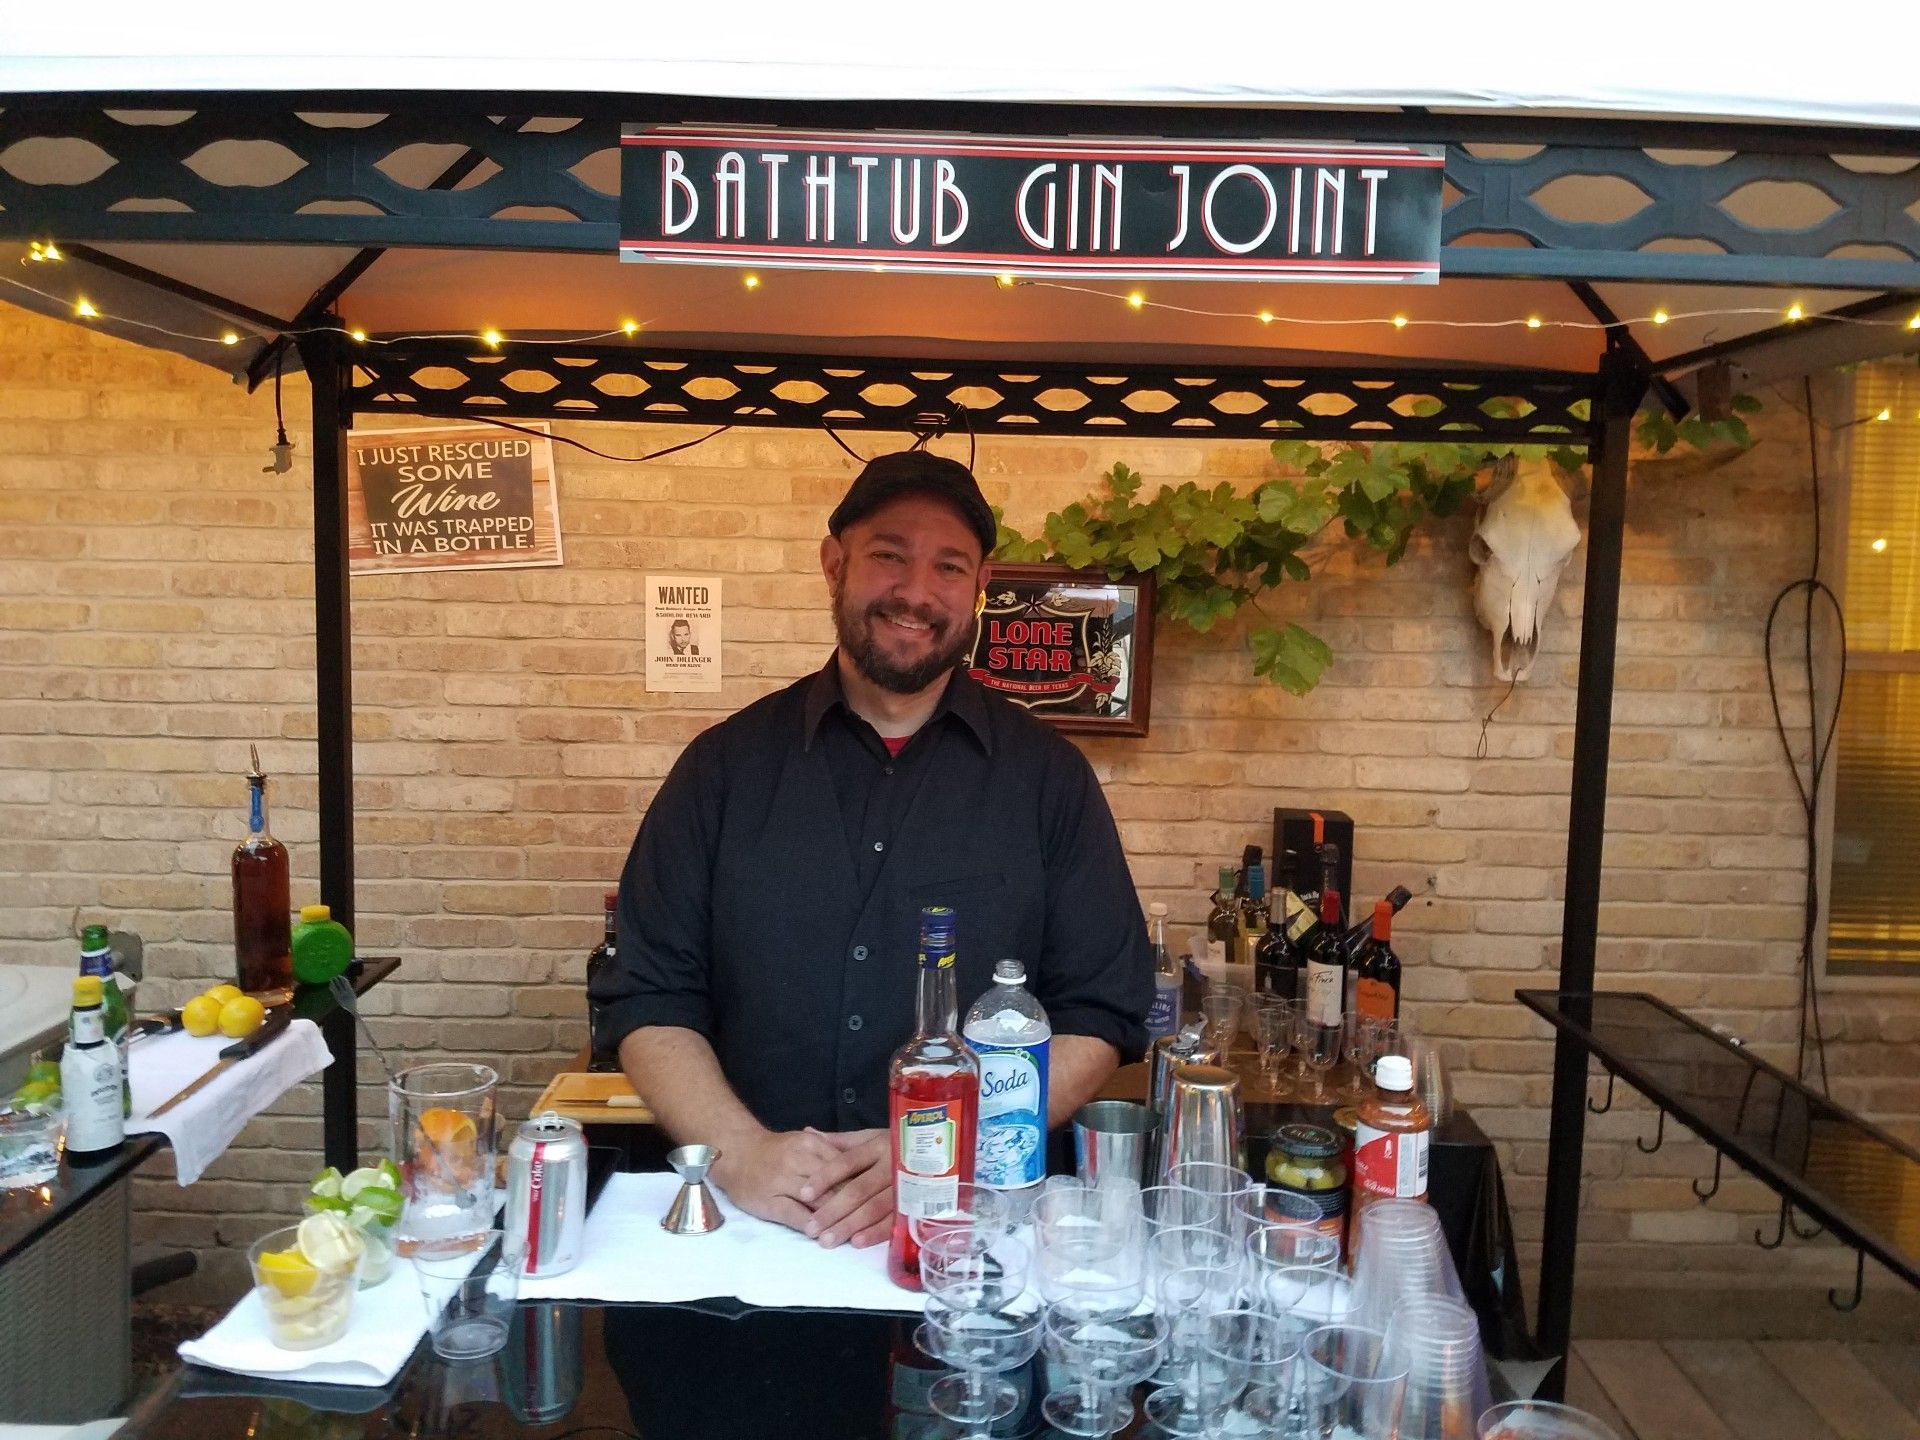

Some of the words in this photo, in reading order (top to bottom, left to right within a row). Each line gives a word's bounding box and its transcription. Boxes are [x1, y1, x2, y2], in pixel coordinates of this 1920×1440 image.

[662, 150, 969, 247] BATHTUB
[1016, 163, 1123, 252] GIN
[1166, 164, 1388, 256] JOINT
[356, 449, 366, 466] I
[370, 446, 422, 465] JUST
[428, 440, 531, 462] RESCUED
[398, 462, 493, 483] SOME
[391, 483, 501, 519] Wine
[370, 522, 388, 538] IT
[392, 520, 439, 537] WAS
[442, 516, 534, 535] TRAPPED
[373, 539, 402, 555] IN
[410, 538, 428, 553] A
[434, 534, 535, 553] BOTTLE.
[658, 586, 709, 605] WANTED
[989, 620, 1074, 646] LONE
[988, 647, 1072, 672] STAR
[1001, 682, 1028, 691] NATIONAL
[1051, 682, 1069, 691] TEXAS
[981, 1069, 1029, 1098] Soda
